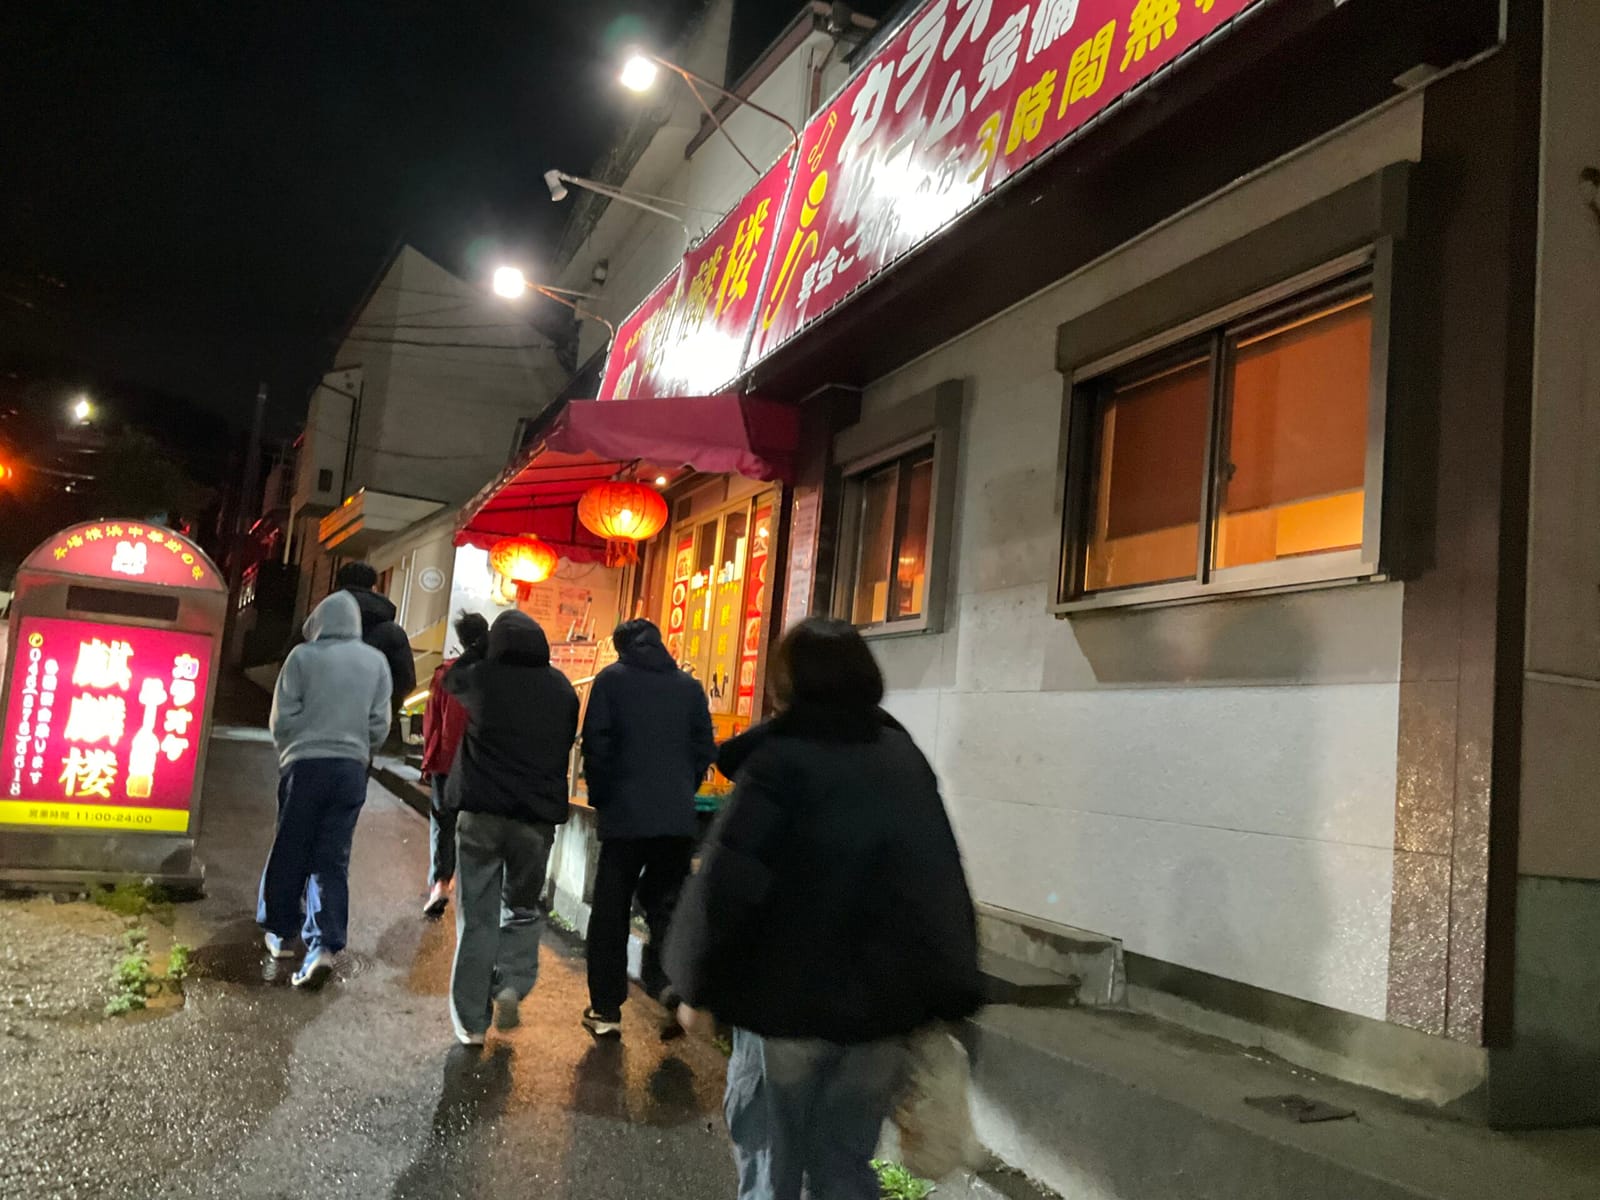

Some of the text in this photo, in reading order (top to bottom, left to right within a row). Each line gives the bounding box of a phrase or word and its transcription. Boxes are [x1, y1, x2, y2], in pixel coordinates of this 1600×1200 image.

[967, 0, 1222, 184] 3時間無
[160, 653, 199, 761] カラオケ
[28, 808, 70, 820] 営業時間
